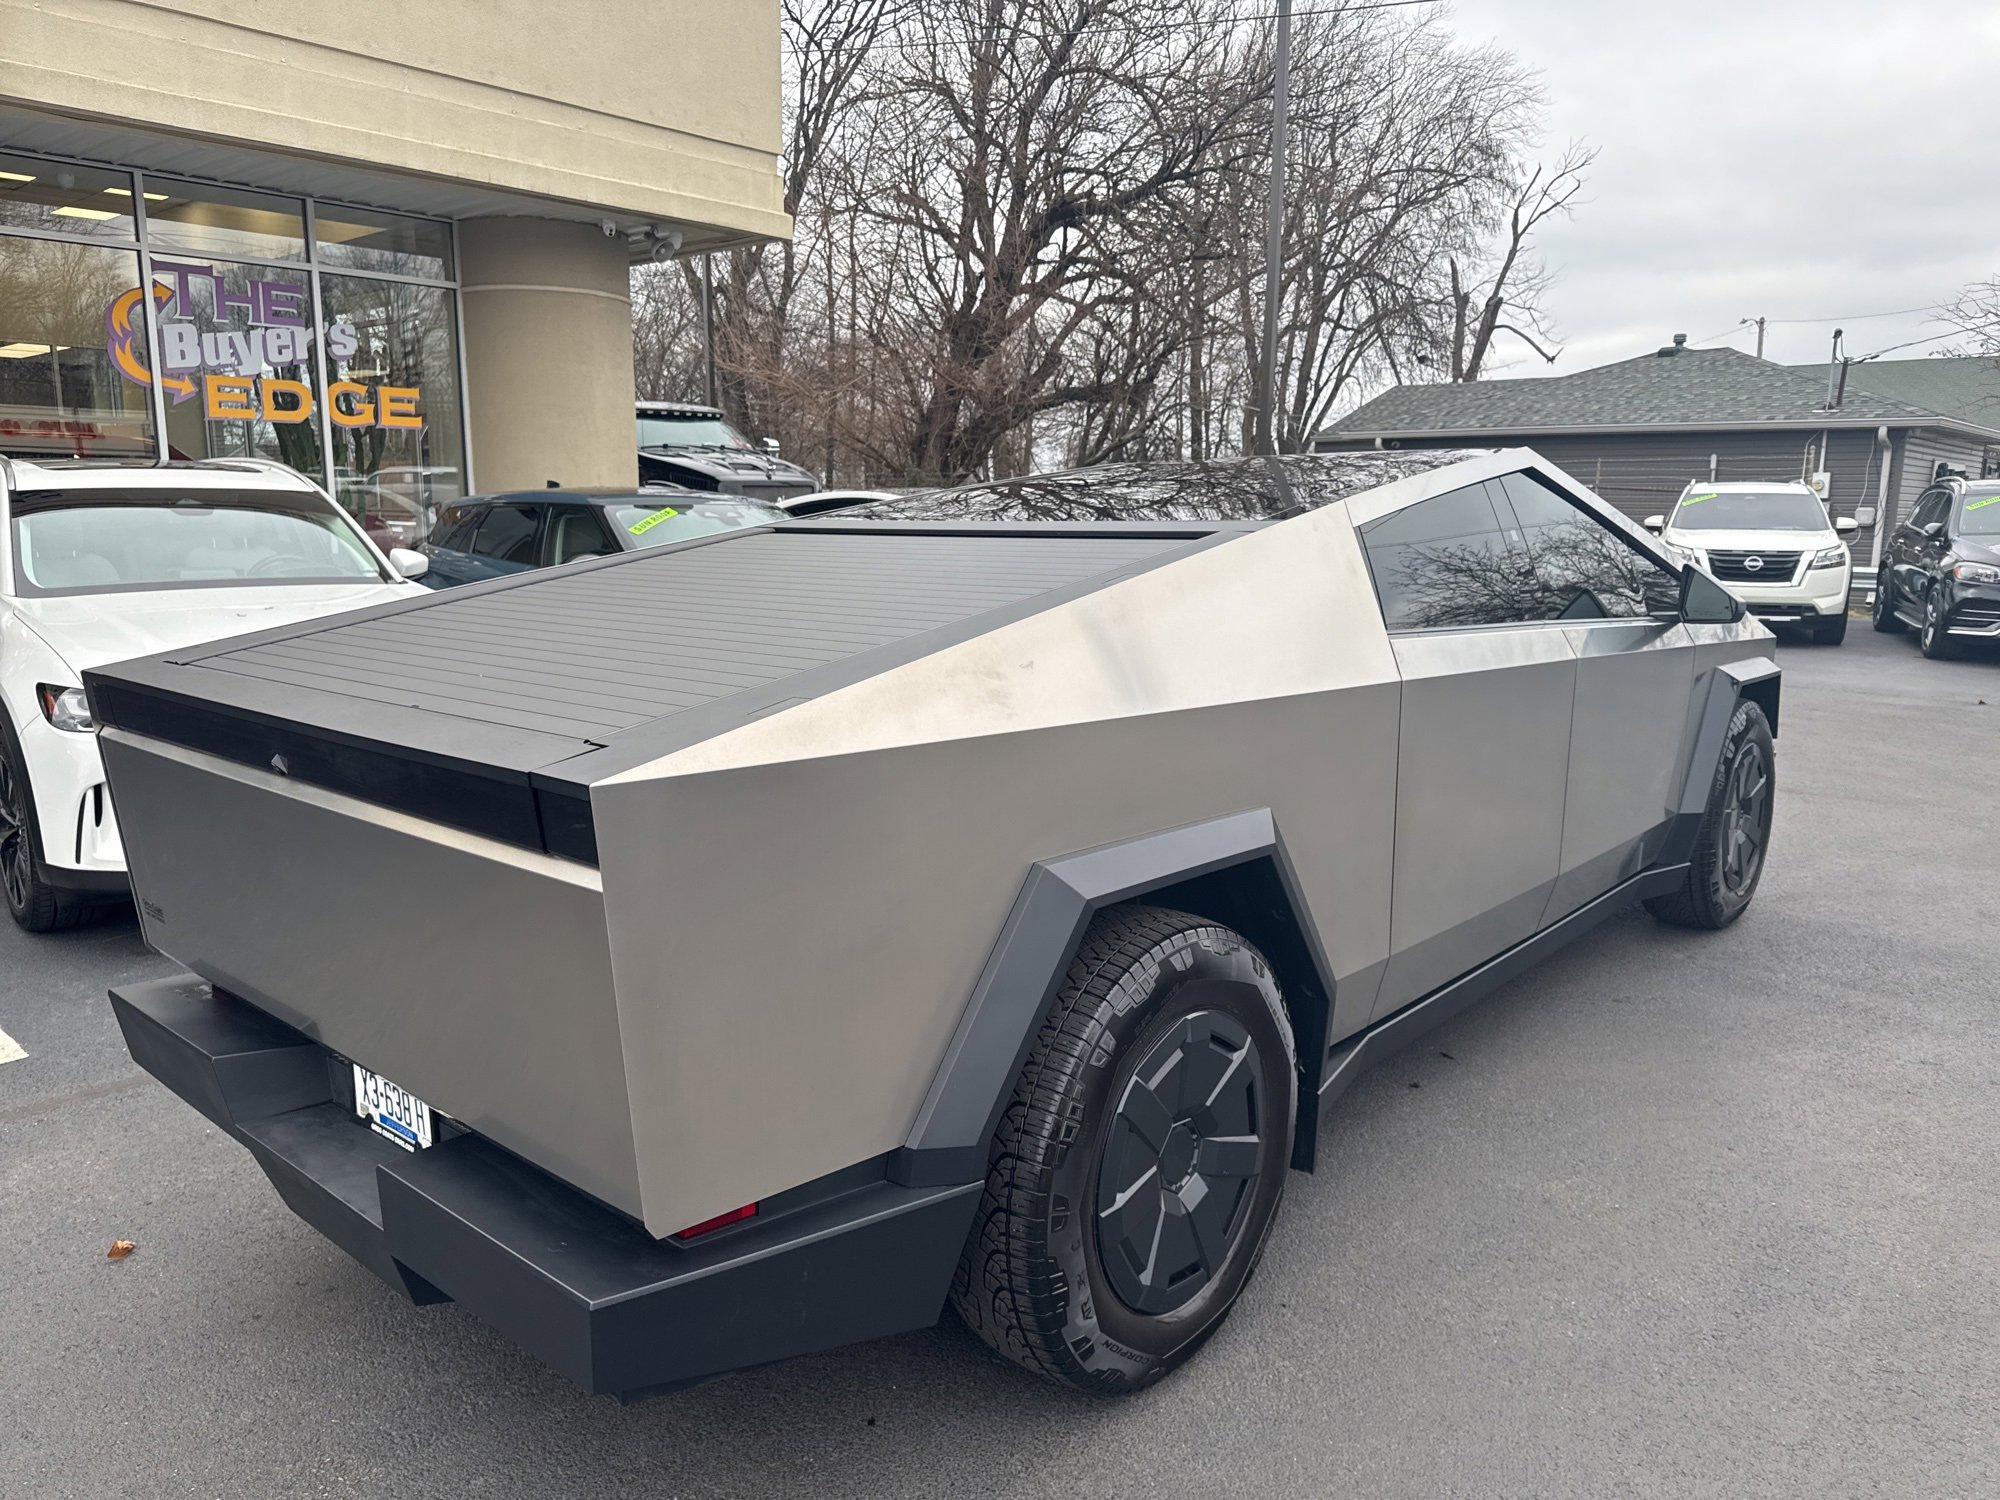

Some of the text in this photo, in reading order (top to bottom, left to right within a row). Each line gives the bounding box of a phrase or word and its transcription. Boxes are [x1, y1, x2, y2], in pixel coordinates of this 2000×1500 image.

[151, 260, 304, 327] THE
[162, 322, 358, 375] Buyer's
[204, 375, 422, 428] EDGE
[633, 519, 652, 532] SUN
